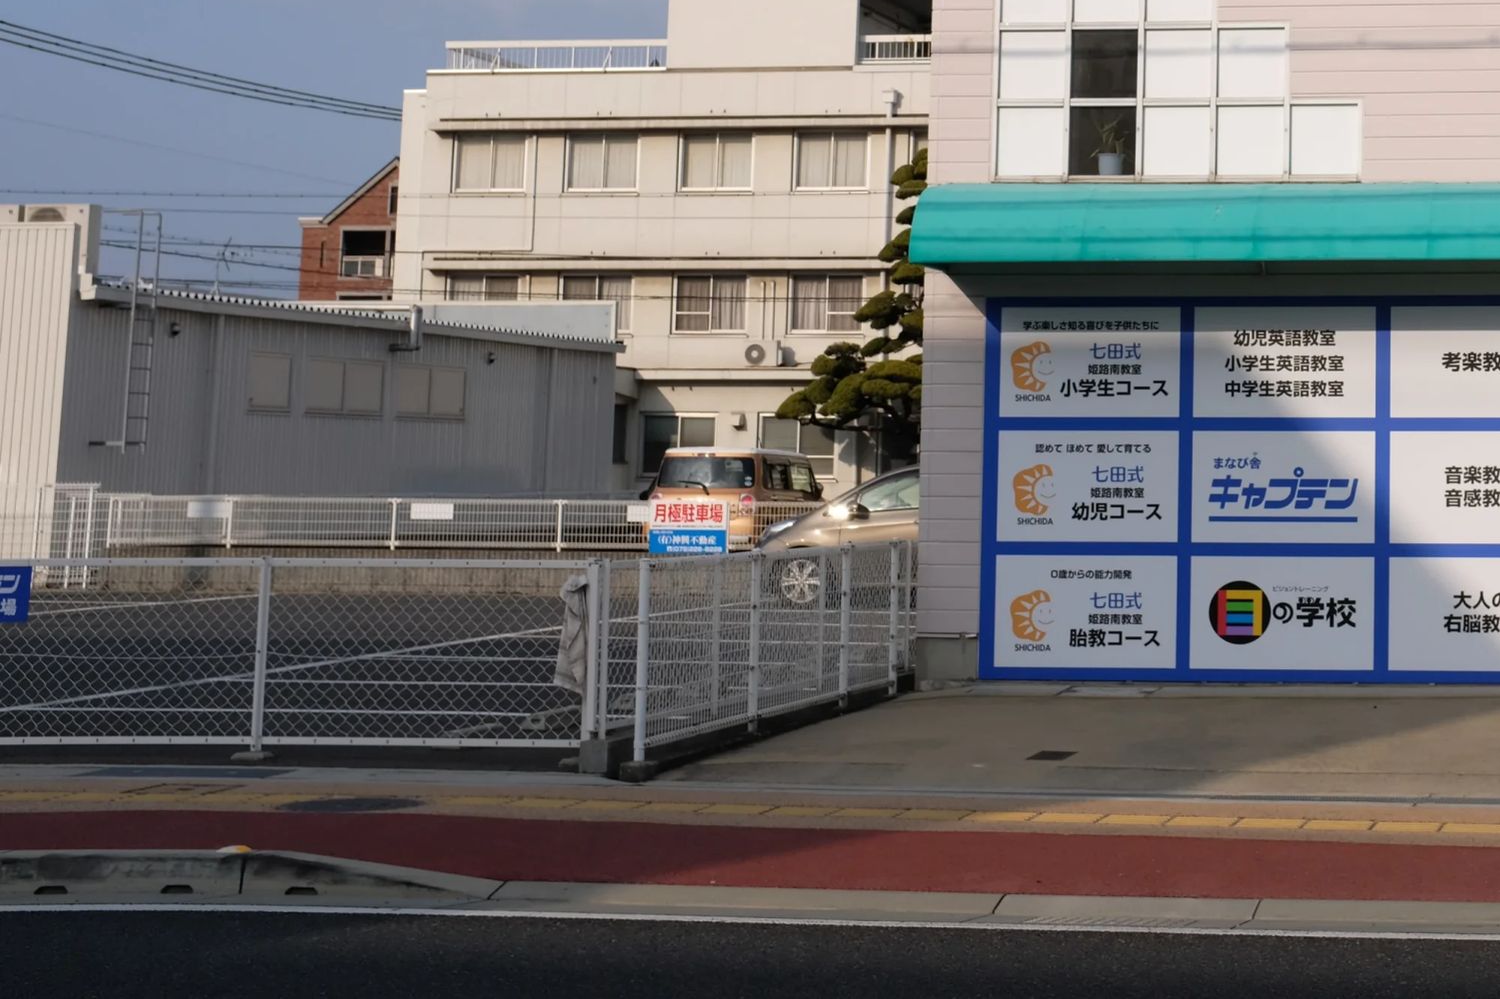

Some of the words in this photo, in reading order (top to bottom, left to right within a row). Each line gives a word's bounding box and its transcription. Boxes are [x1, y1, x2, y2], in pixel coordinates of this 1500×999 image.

[1023, 320, 1159, 331] 学ぶ楽しさ知る喜びを子供たちに
[1233, 329, 1336, 347] 幼児英語教室
[1089, 342, 1142, 360] 七田式
[1088, 364, 1142, 375] 姫路南教室
[1224, 355, 1344, 372] 小学生英語教室
[1060, 379, 1169, 397] 小学生コース
[1224, 380, 1344, 398] 中学生英語教室
[1015, 394, 1051, 402] SHICHIDA
[1066, 444, 1094, 454] ほめて
[1213, 457, 1261, 470] まなび舎
[1092, 465, 1144, 483] 七田式
[1090, 487, 1145, 498] 姫路南教室
[1208, 467, 1359, 510] キャプテン
[654, 503, 723, 523] 月極駐車場
[1072, 502, 1162, 521] 幼児コース
[1017, 517, 1053, 525] SHICHIDA
[1090, 592, 1143, 609] 七田式
[1088, 614, 1143, 625] 姫路南教室
[1069, 629, 1160, 647] 胎教コース
